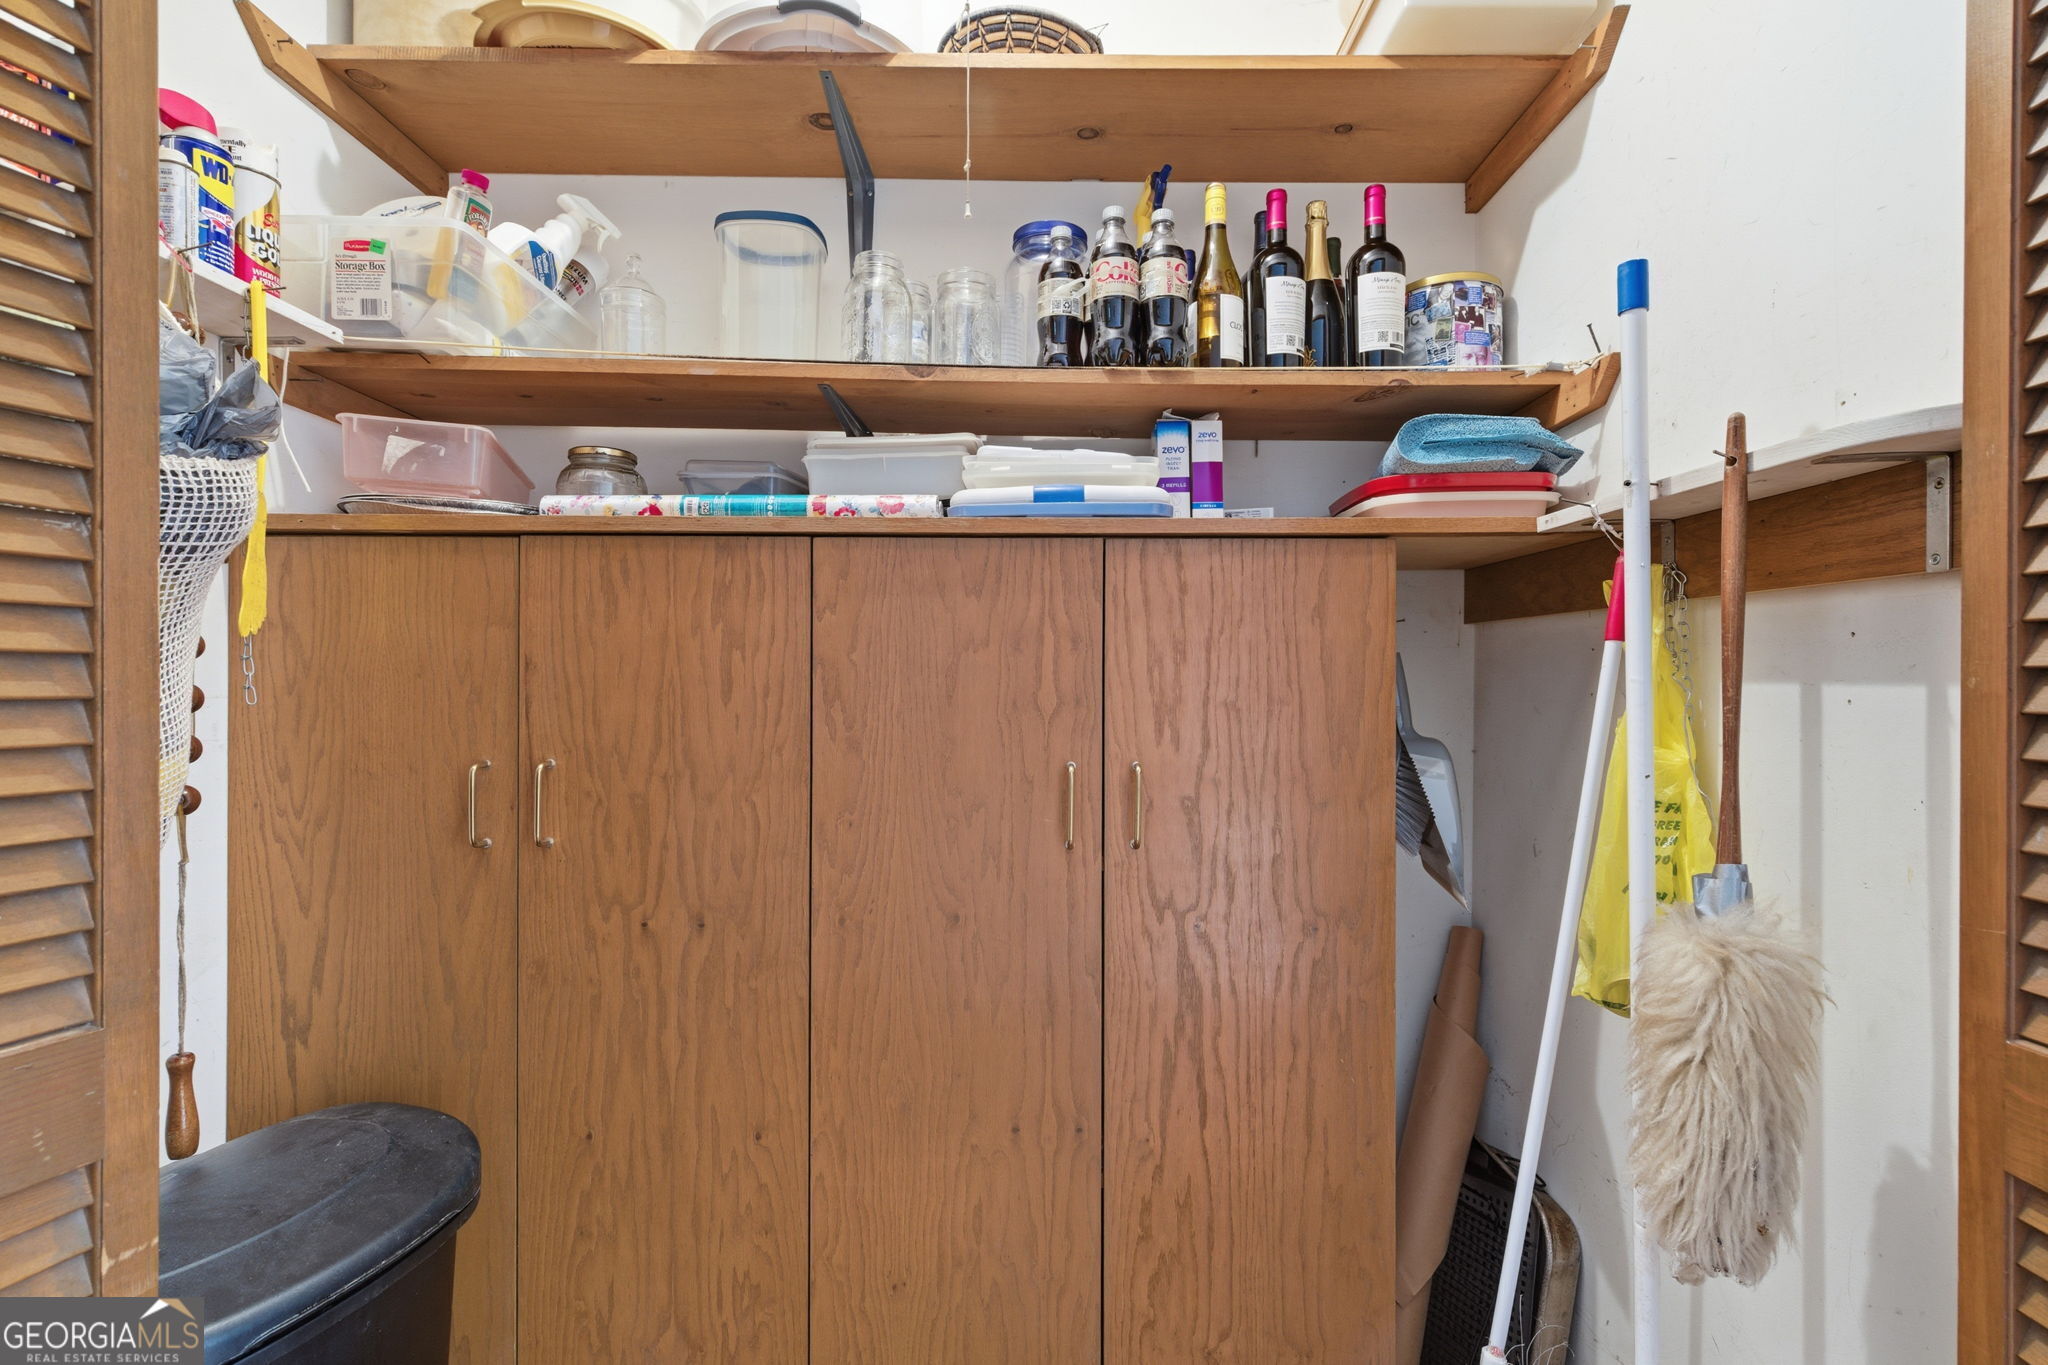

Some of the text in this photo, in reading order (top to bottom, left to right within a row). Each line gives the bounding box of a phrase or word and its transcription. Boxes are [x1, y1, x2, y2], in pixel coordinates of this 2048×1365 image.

[335, 260, 385, 272] Storage Box
[1162, 446, 1185, 454] zevo
